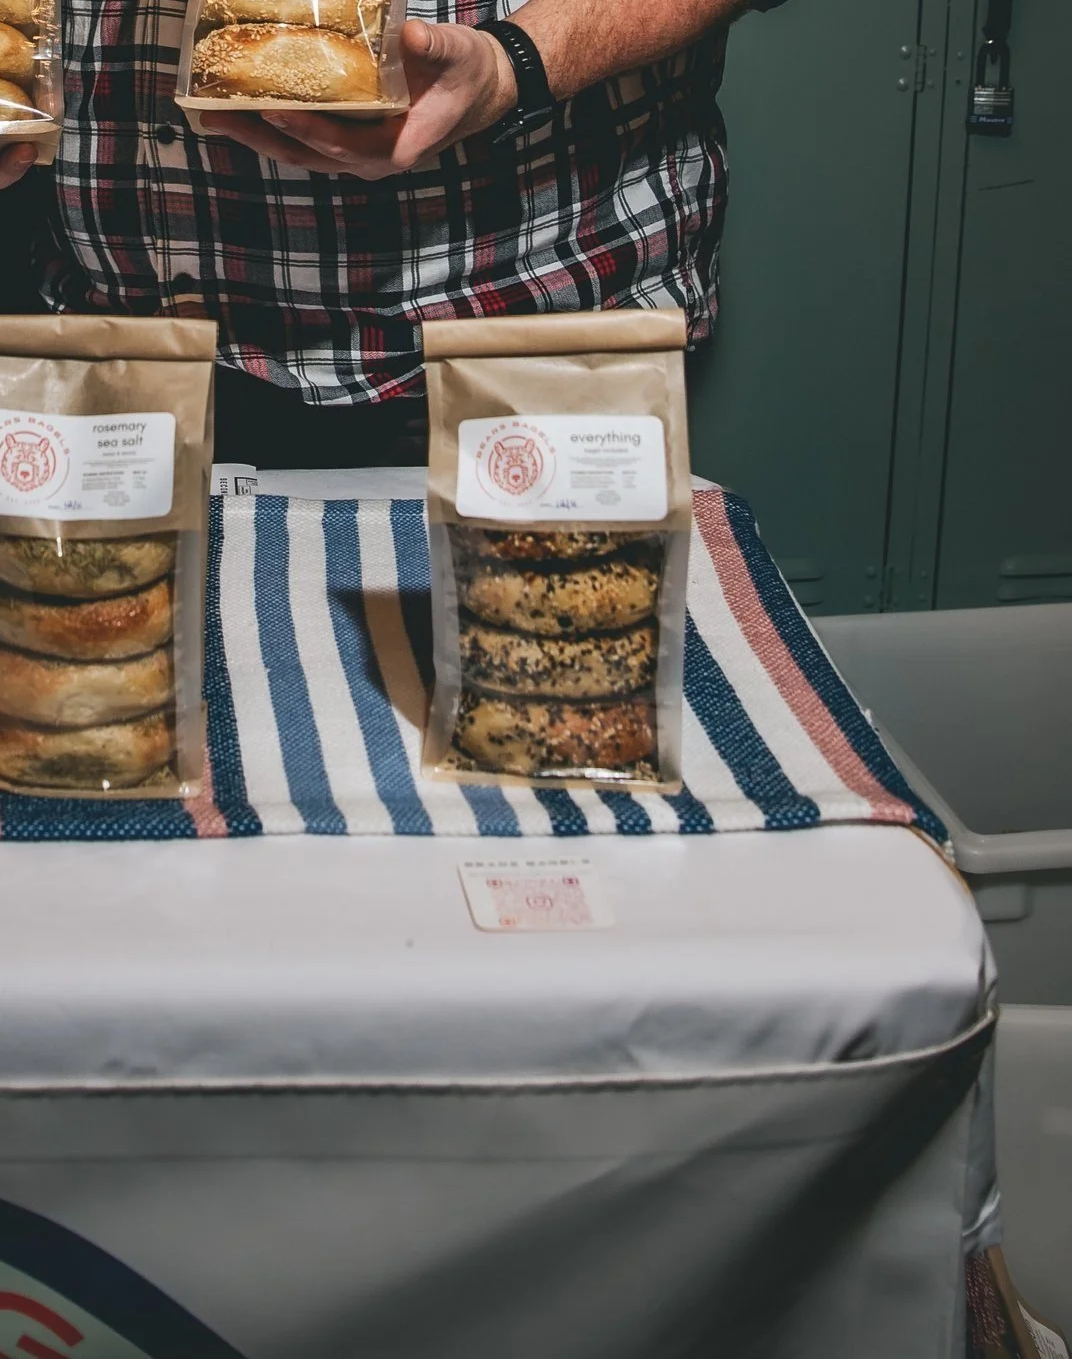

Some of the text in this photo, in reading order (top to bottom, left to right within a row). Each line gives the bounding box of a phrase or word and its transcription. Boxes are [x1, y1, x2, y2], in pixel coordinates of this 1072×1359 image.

[92, 421, 147, 435] rosemary
[28, 417, 71, 455] BAGELS
[97, 435, 144, 449] sea salt
[570, 429, 641, 446] everything
